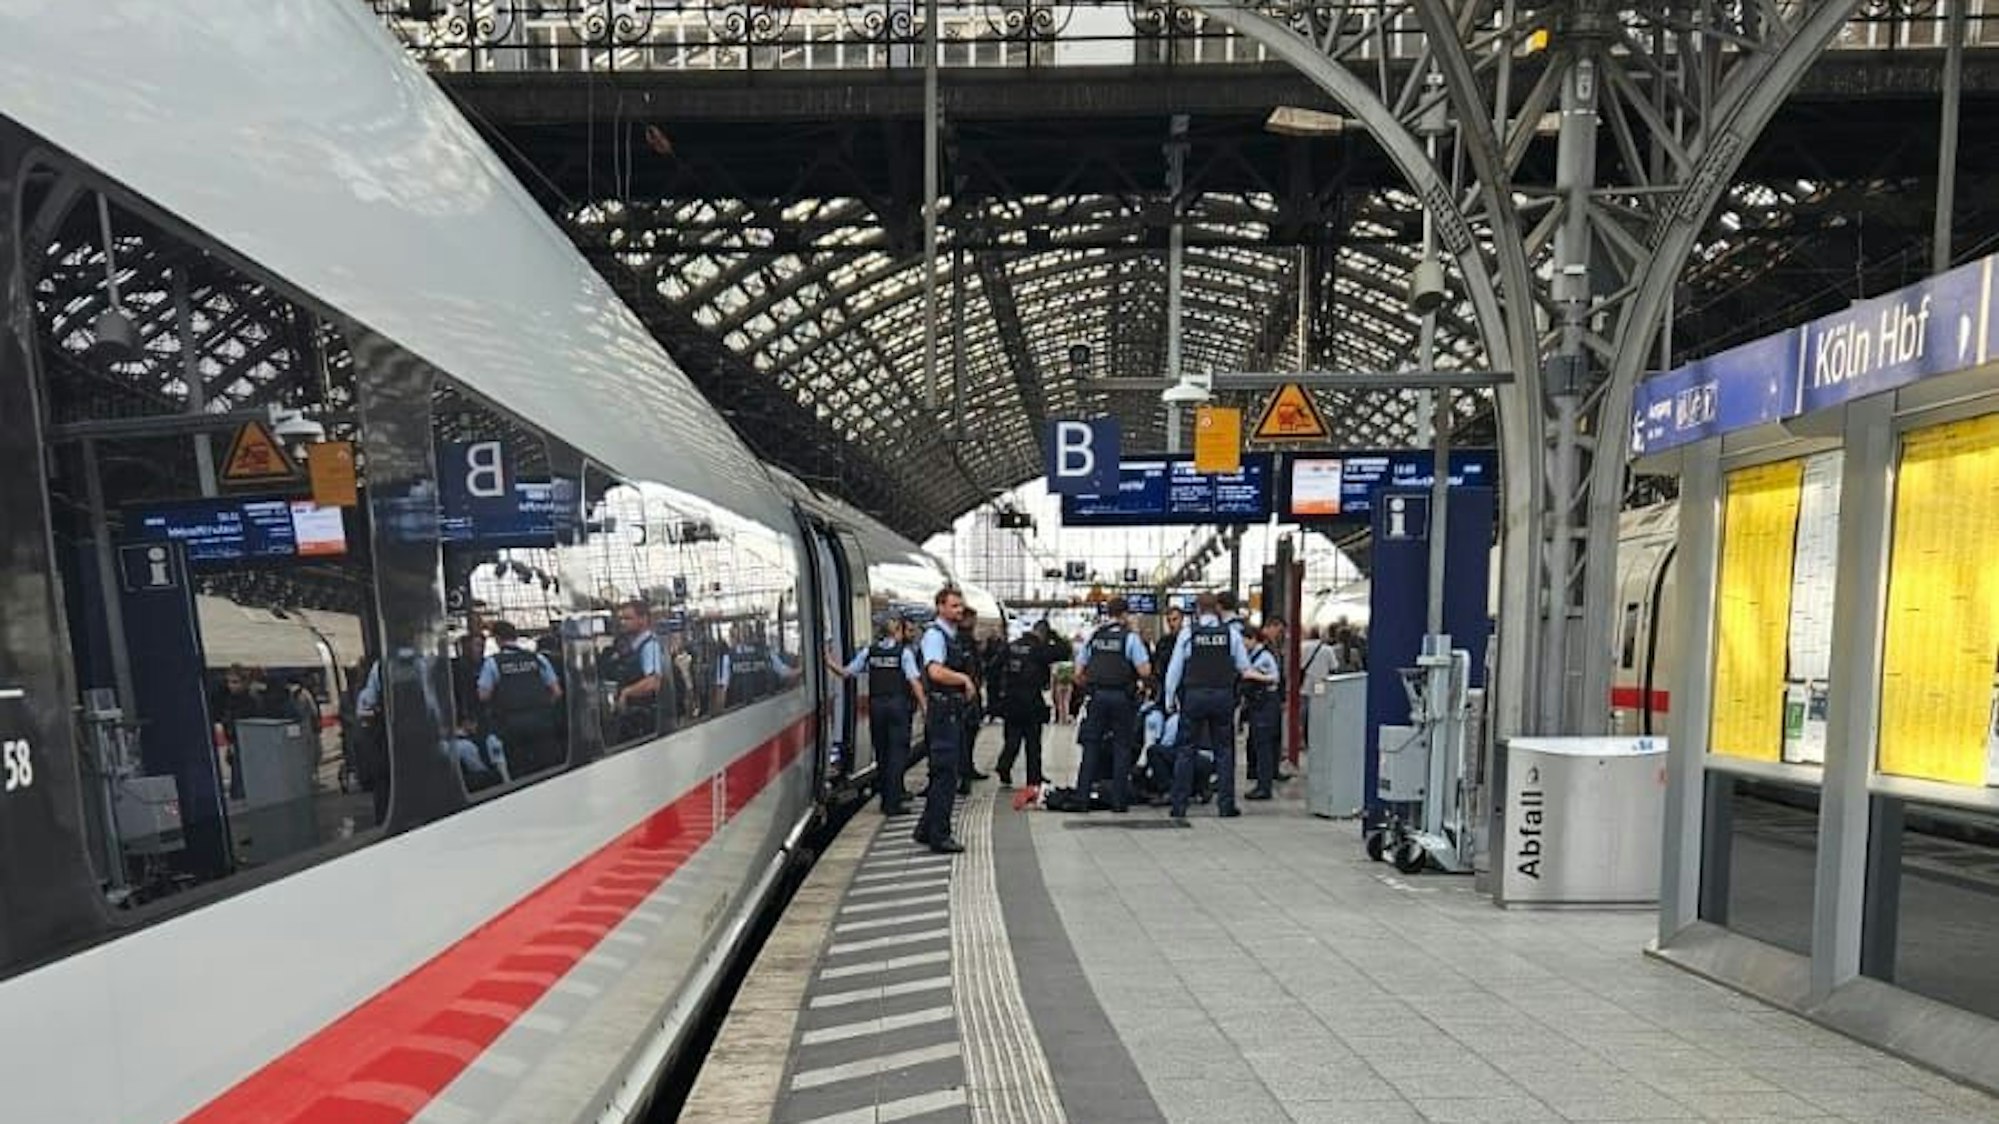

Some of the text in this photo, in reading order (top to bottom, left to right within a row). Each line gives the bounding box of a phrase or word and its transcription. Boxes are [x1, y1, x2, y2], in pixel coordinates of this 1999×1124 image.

[1814, 295, 1931, 388] Köln Hbf
[1056, 420, 1095, 477] B
[3, 739, 33, 792] 58
[1517, 791, 1544, 880] Abfall
